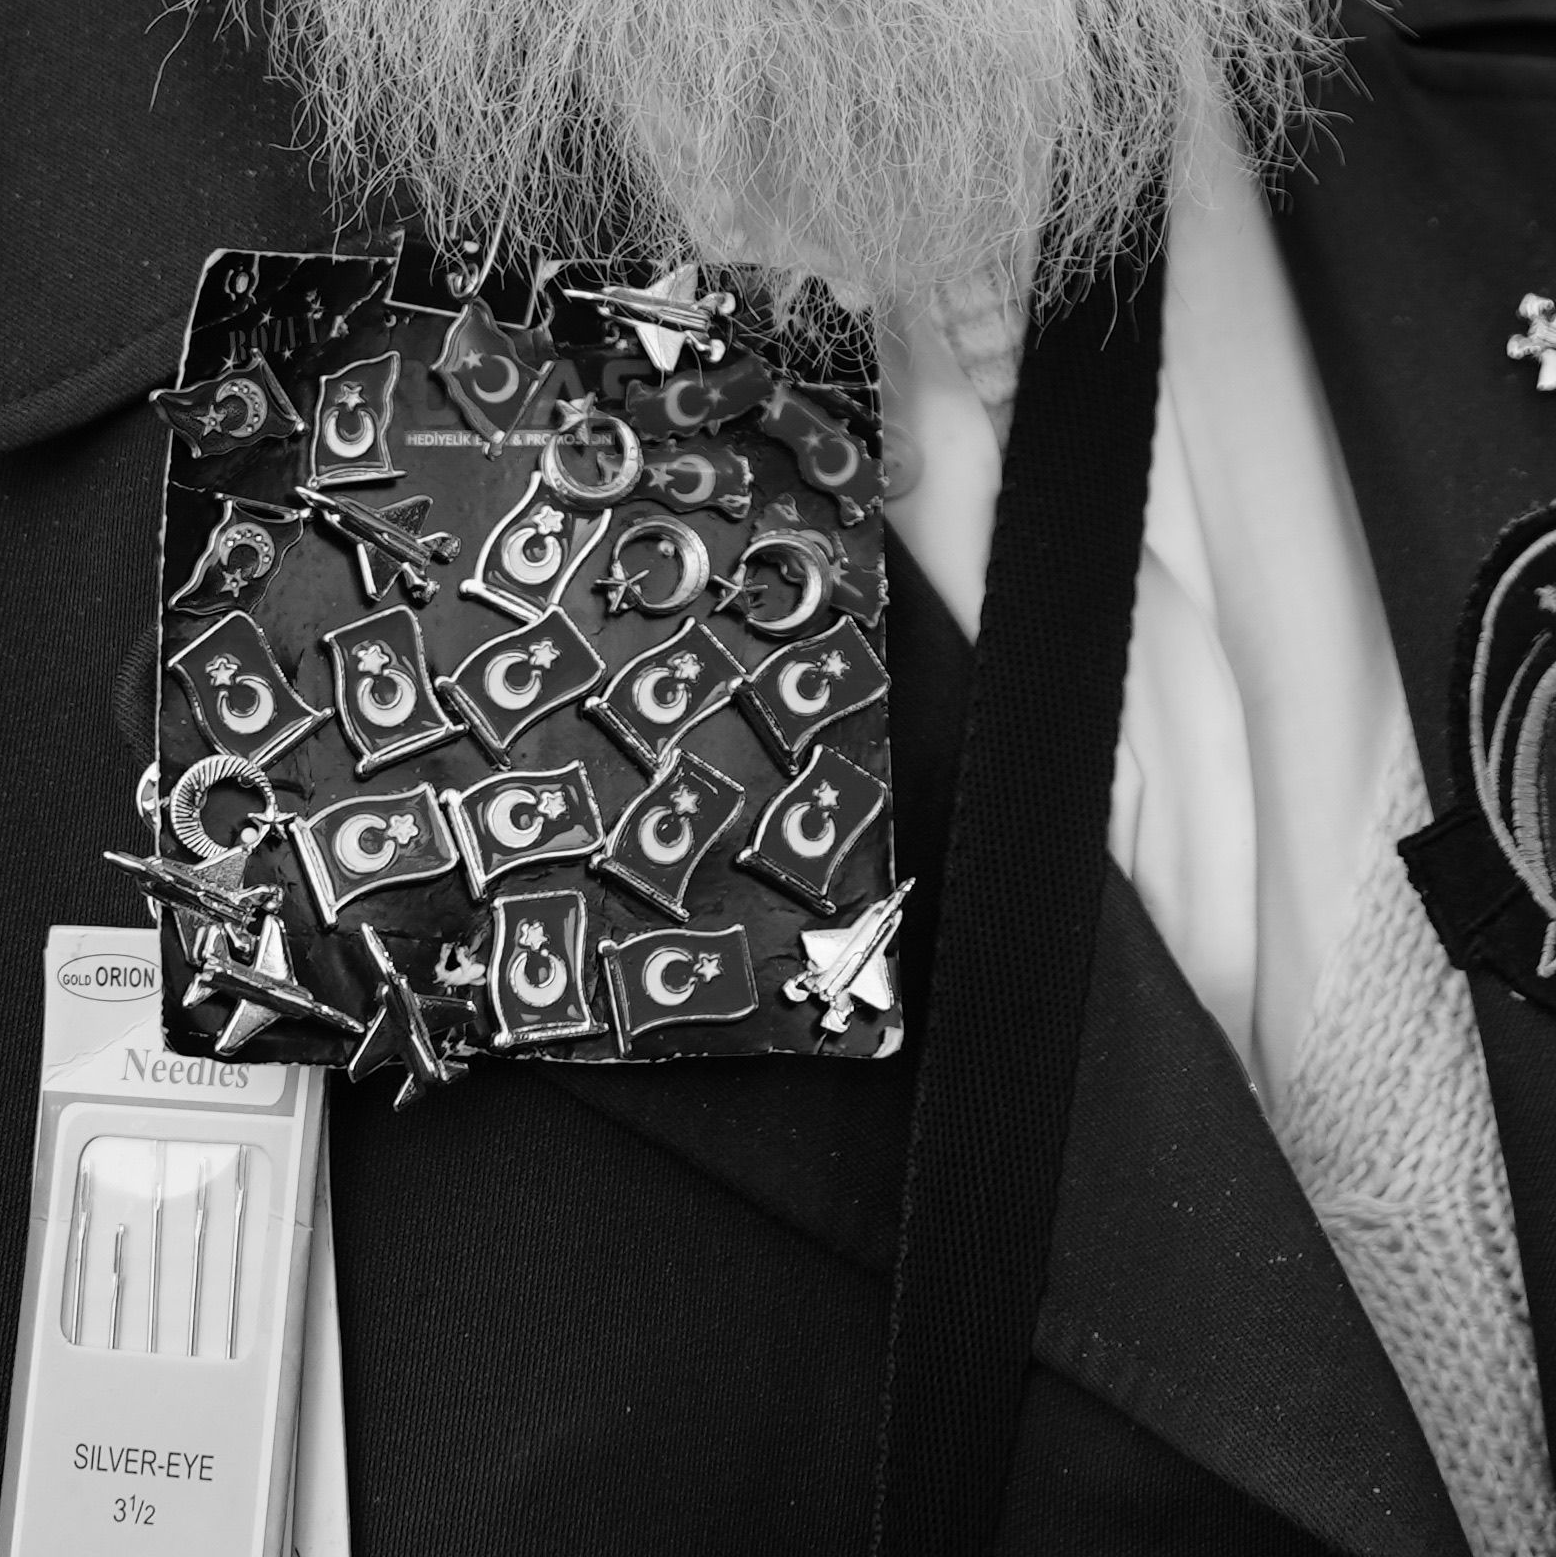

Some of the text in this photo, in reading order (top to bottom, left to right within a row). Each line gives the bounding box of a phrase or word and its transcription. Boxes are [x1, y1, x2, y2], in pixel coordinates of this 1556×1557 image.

[406, 431, 472, 446] HEDİYELİK
[512, 433, 523, 446] &
[62, 965, 156, 989] GOLD ORION
[120, 1047, 252, 1089] Needles
[73, 1442, 215, 1482] SILVER-EYE
